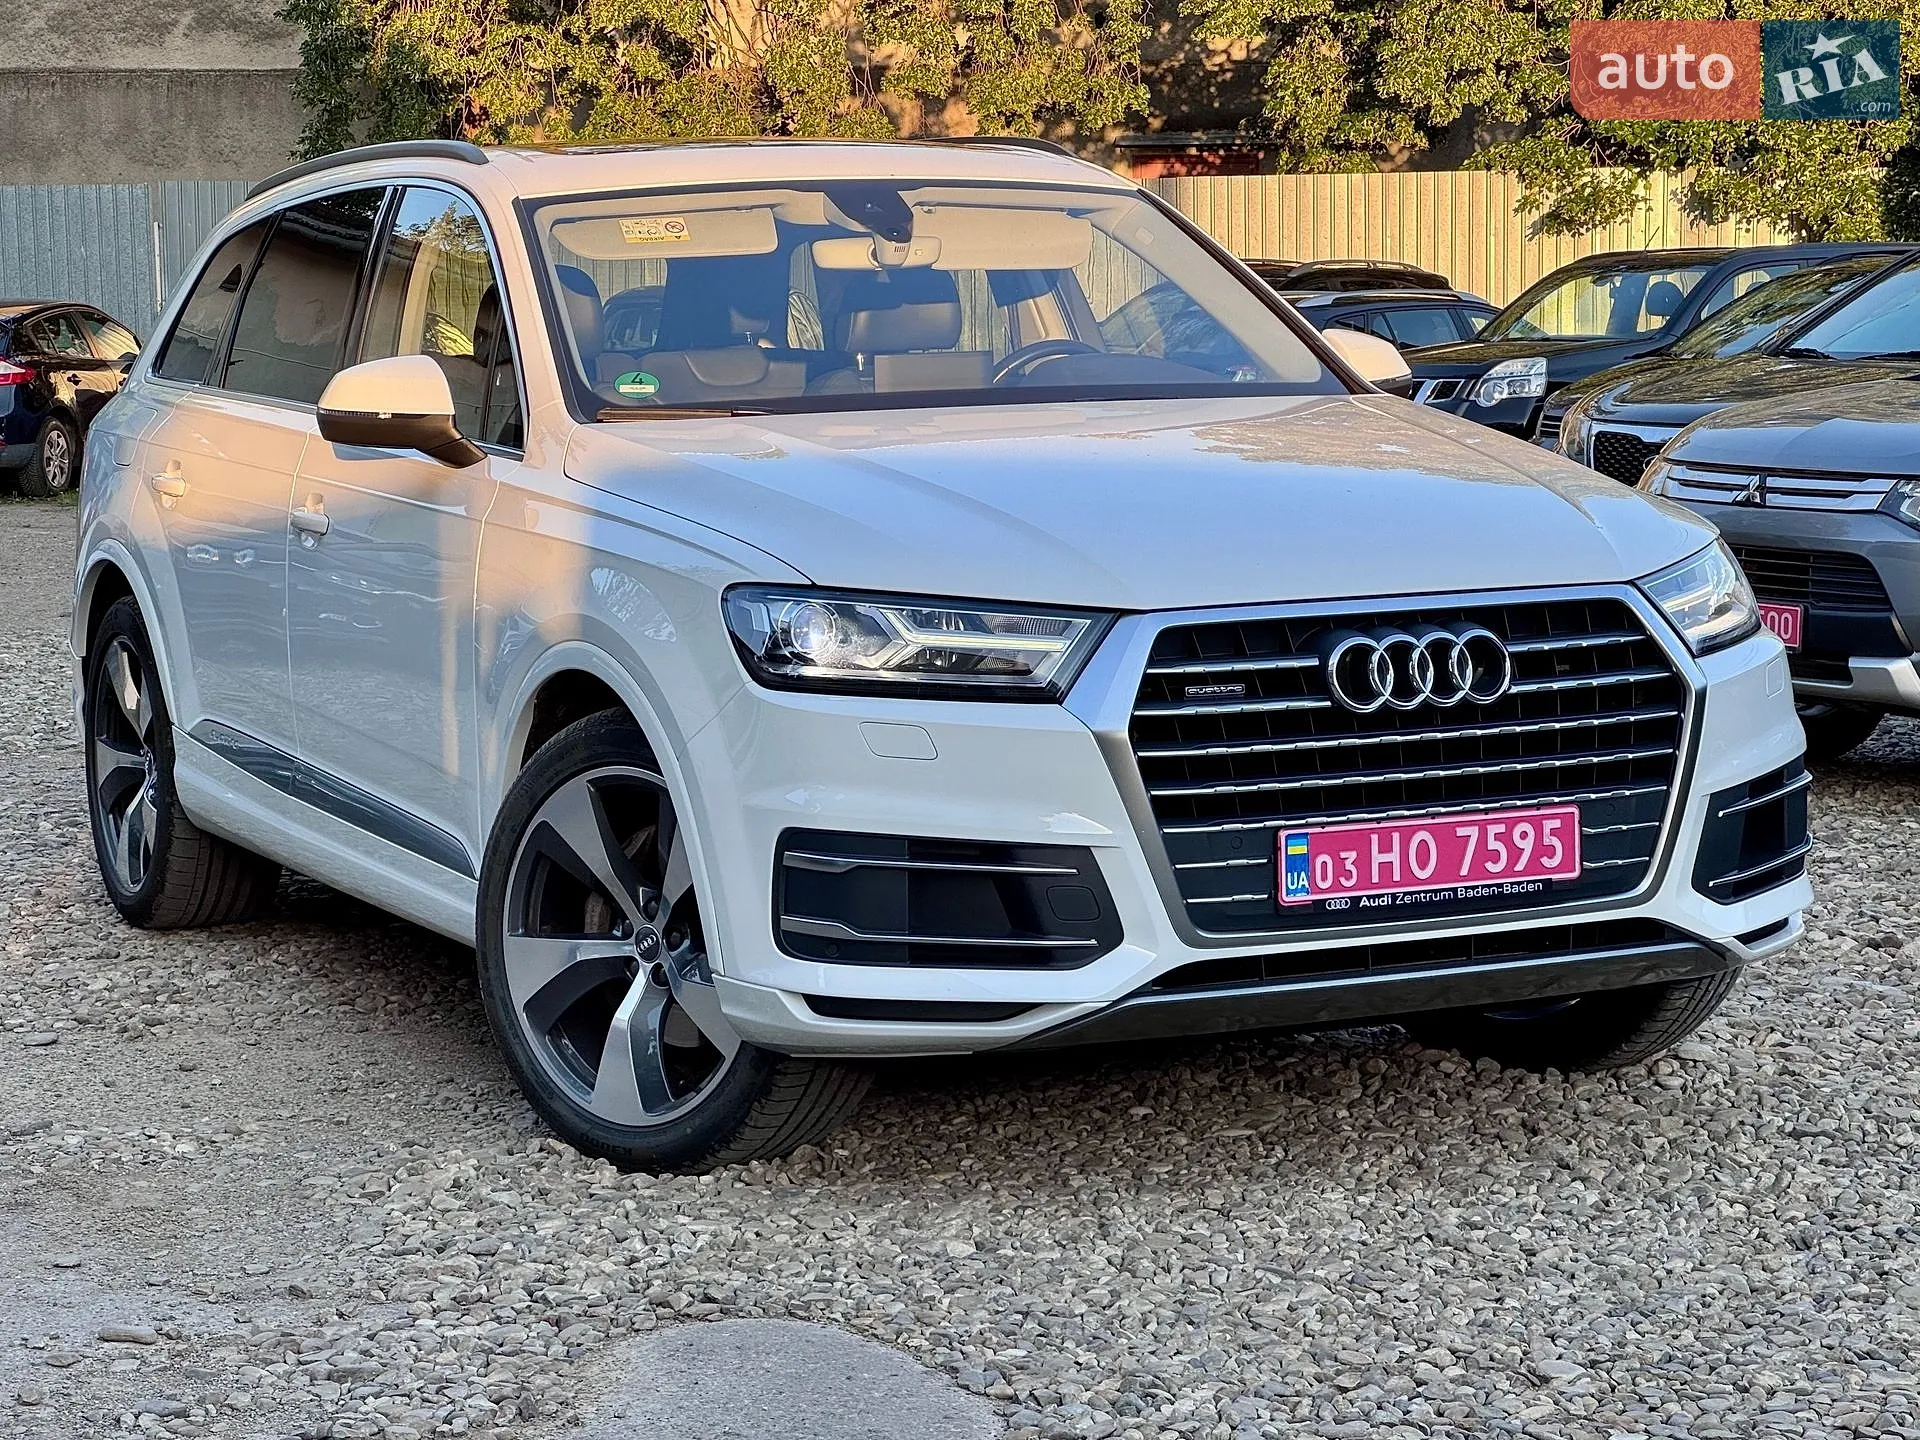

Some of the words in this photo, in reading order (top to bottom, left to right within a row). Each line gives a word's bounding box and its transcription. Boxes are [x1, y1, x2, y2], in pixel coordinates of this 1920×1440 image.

[631, 373, 644, 385] 4
[1760, 609, 1793, 640] 00
[1188, 685, 1243, 694] quattro
[1314, 850, 1358, 890] 03
[1369, 830, 1438, 883] HO
[1455, 818, 1564, 877] 7595
[1287, 872, 1309, 890] UA
[1359, 894, 1392, 908] Audi
[1396, 889, 1454, 904] Zentrum
[1457, 880, 1543, 898] Baden-Baden
